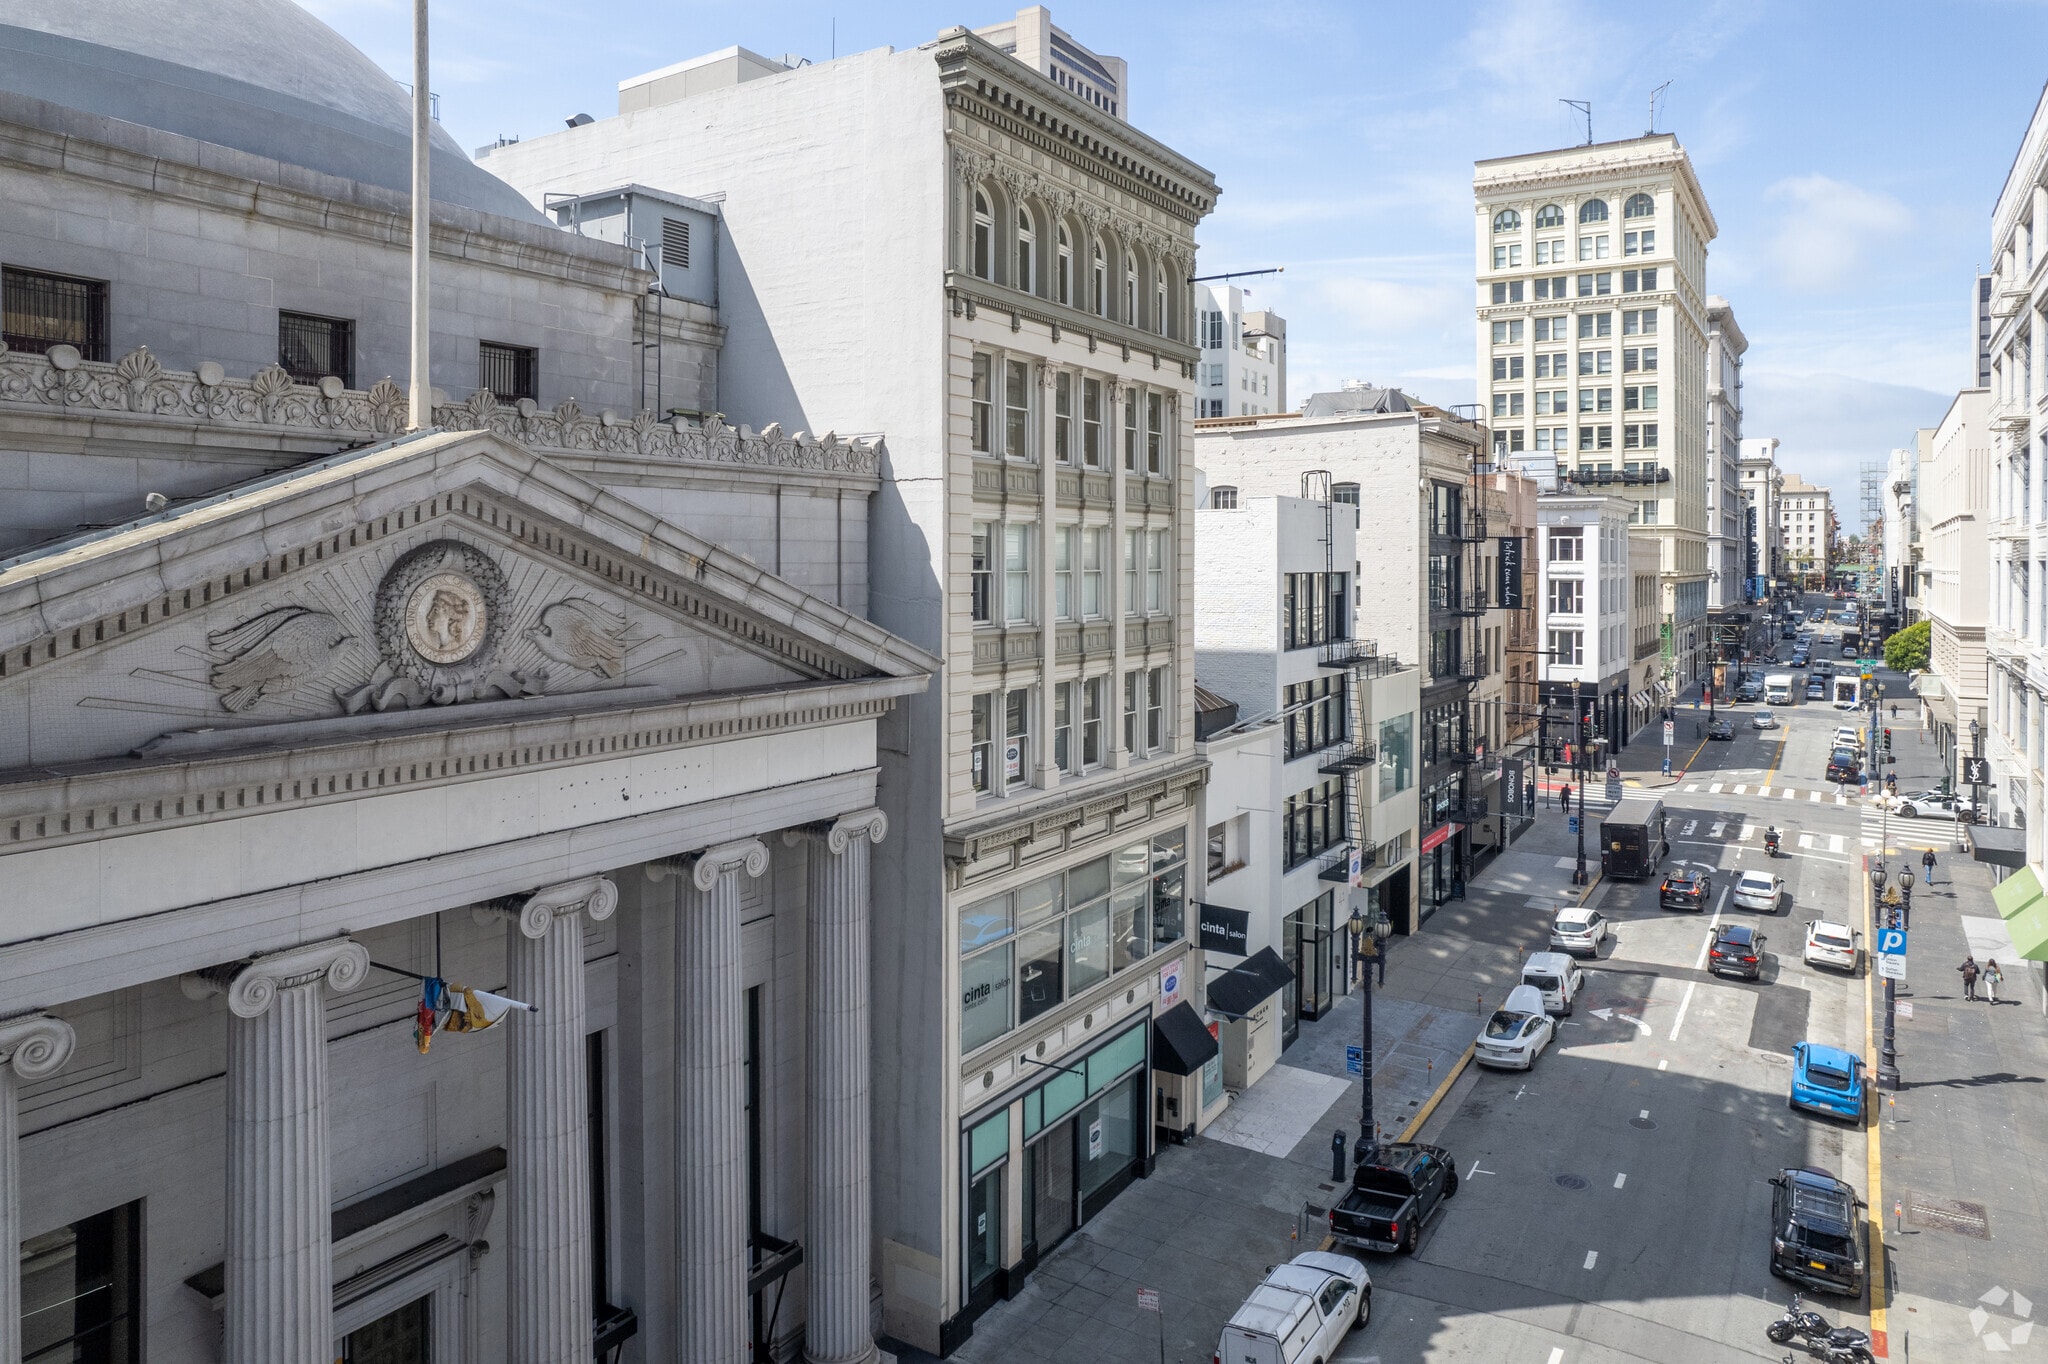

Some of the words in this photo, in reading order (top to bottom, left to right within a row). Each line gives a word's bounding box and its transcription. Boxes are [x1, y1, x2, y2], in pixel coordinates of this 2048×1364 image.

[1503, 541, 1516, 567] Patrick
[406, 591, 422, 627] UNION
[1507, 770, 1516, 803] BONOBOS
[1201, 921, 1225, 936] cinta
[1229, 930, 1246, 939] salon
[1881, 931, 1903, 951] P
[1070, 935, 1091, 954] cinta
[964, 983, 990, 1004] cinta
[995, 977, 1011, 991] salon
